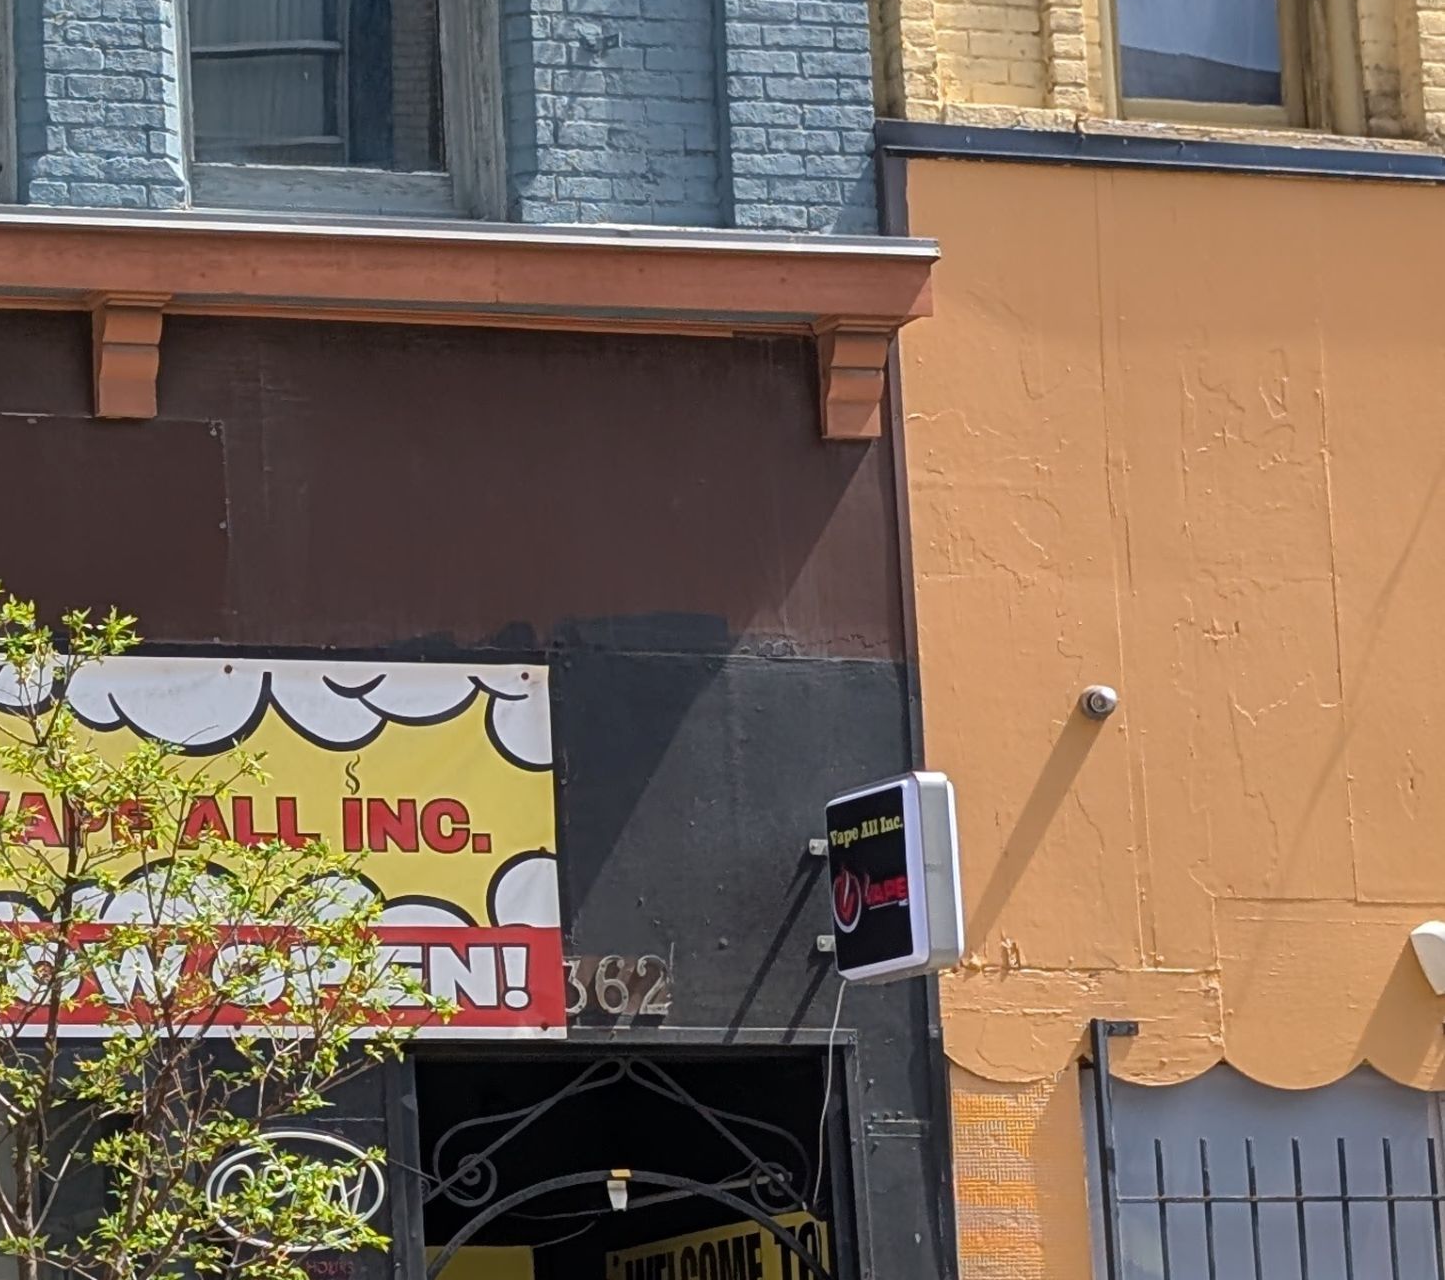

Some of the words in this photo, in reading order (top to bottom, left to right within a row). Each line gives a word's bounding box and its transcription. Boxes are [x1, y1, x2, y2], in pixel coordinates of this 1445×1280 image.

[176, 794, 321, 852] ALL
[342, 796, 492, 854] INC.
[830, 828, 859, 849] Vape
[860, 818, 879, 839] All
[880, 816, 904, 834] Inc.
[210, 942, 531, 1010] OPEN!
